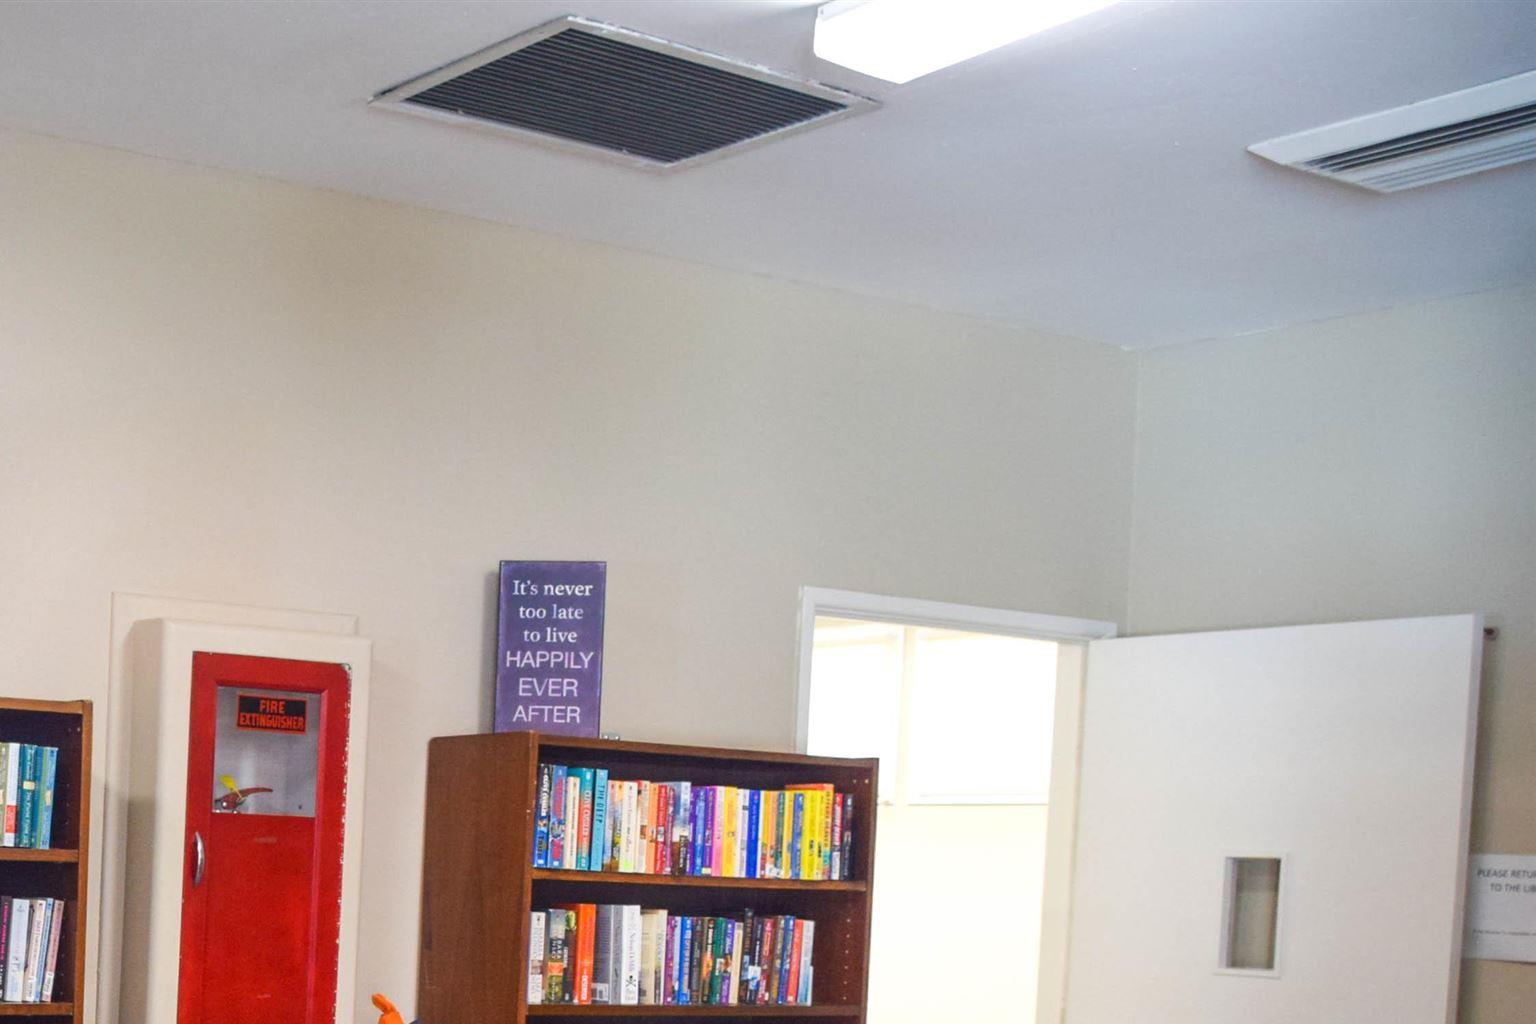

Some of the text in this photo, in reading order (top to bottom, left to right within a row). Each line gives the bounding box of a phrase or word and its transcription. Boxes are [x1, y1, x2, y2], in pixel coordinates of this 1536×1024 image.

[513, 580, 594, 596] It's never
[519, 604, 584, 619] too late
[523, 627, 578, 643] to live
[505, 651, 594, 669] HAPPILY
[518, 678, 578, 697] EVER
[259, 700, 286, 714] FIRE
[513, 705, 580, 724] AFTER
[239, 713, 304, 731] EXTINGUISHER
